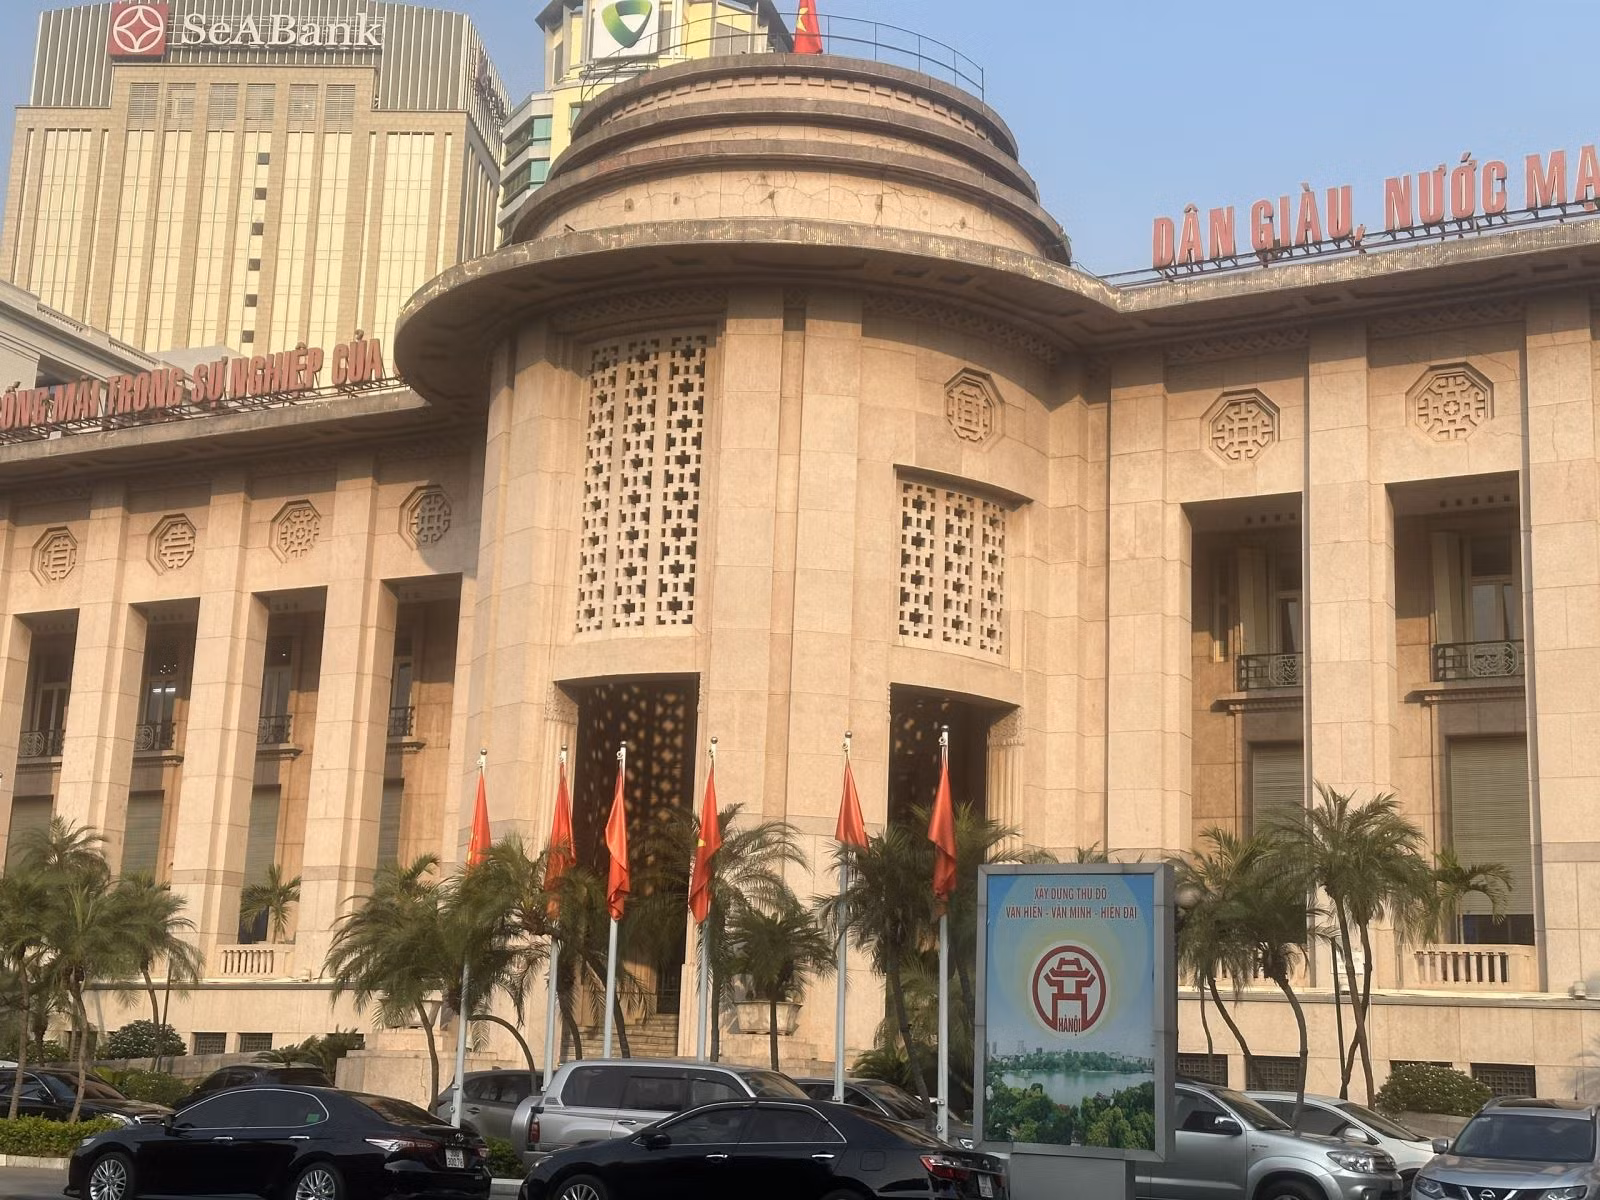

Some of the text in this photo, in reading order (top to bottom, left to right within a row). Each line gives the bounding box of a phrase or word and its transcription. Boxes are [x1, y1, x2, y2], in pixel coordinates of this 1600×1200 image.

[181, 12, 382, 46] SeABank
[1152, 203, 1237, 268] DÂN
[1251, 182, 1366, 251] GIÀU,
[1384, 152, 1508, 231] NƯỚC
[0, 381, 49, 431] ỐNG
[51, 374, 101, 422] MÃI
[106, 367, 186, 417] TRONG
[191, 356, 228, 408] SỰ
[229, 341, 324, 399] NGHIỆP
[331, 328, 384, 385] CỦA
[1070, 906, 1092, 919] MINH
